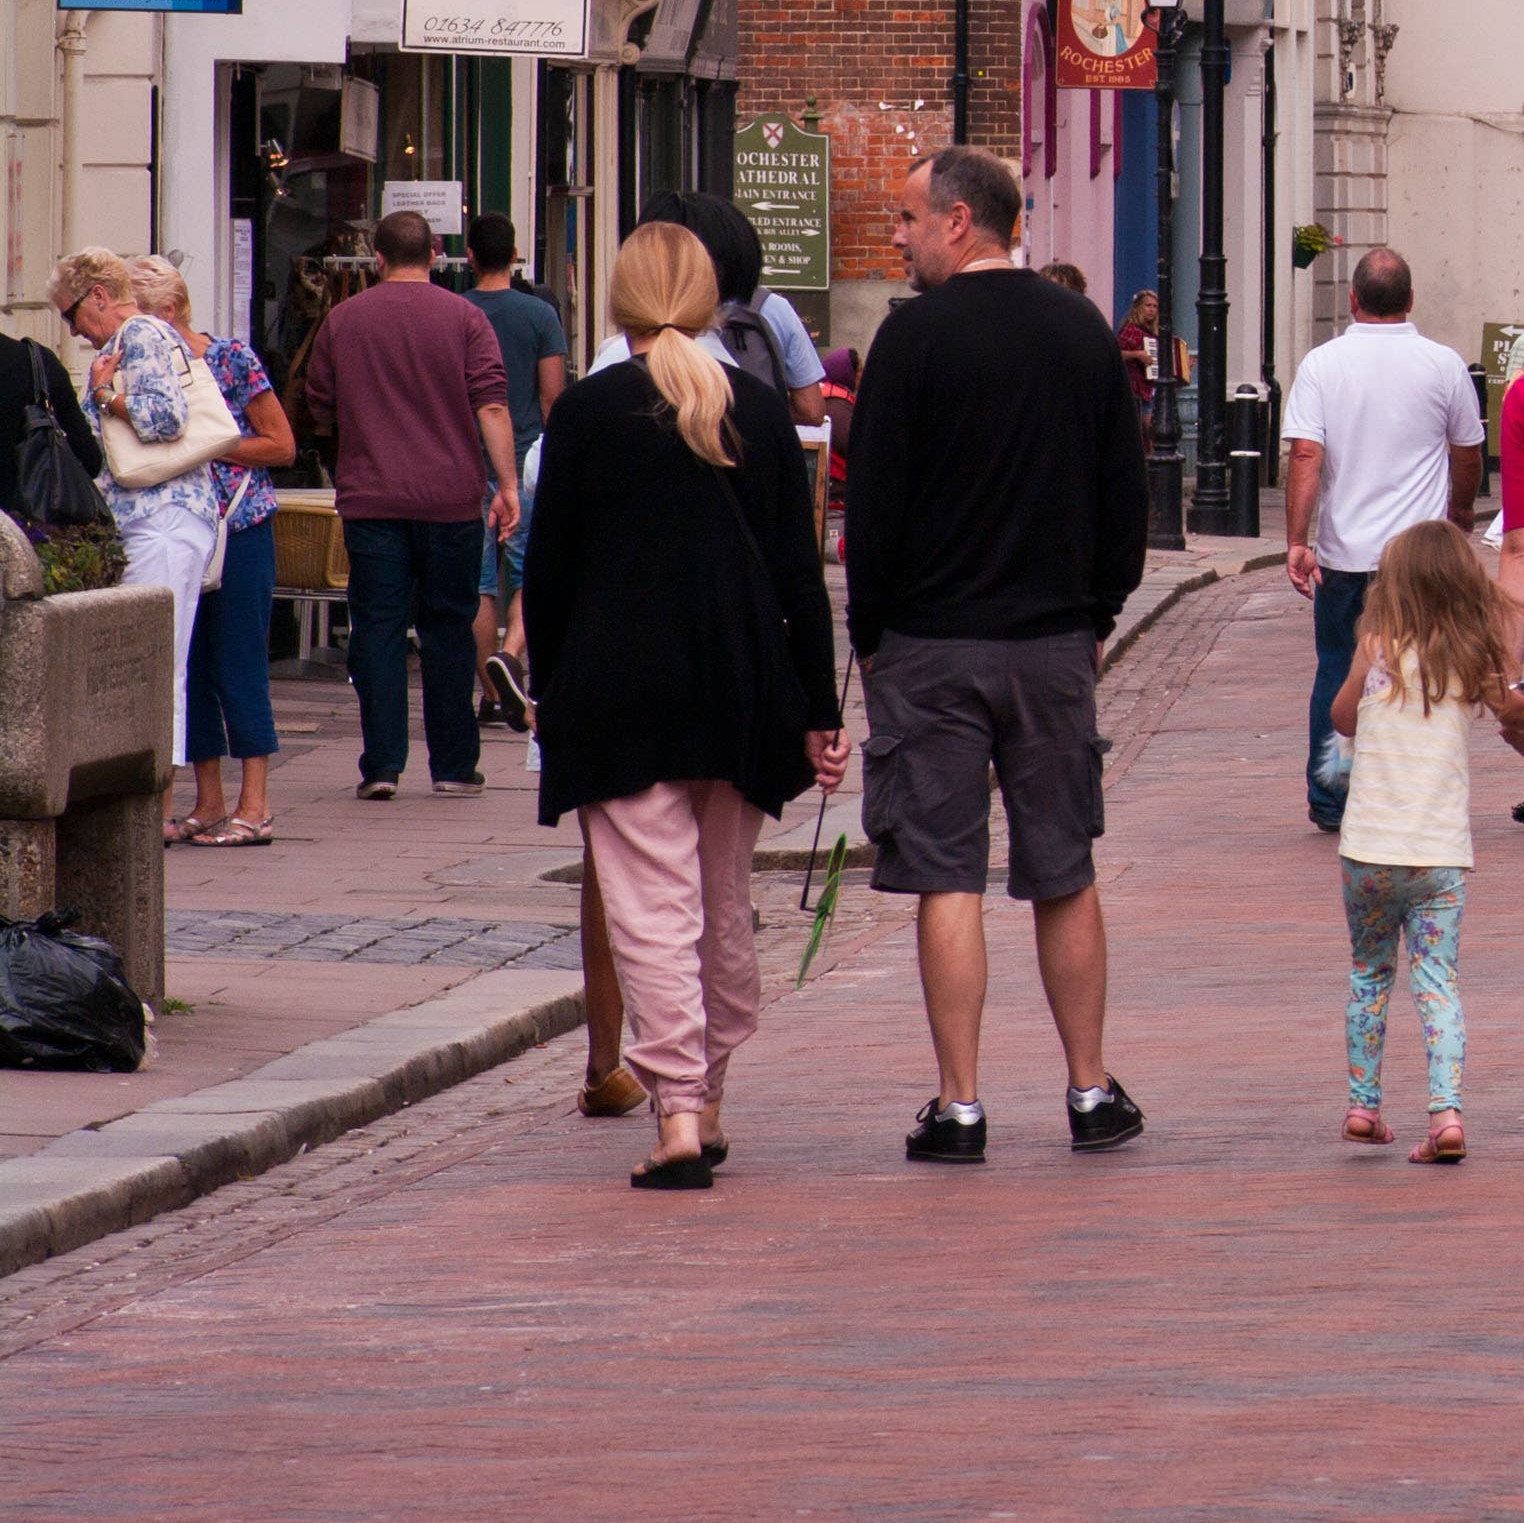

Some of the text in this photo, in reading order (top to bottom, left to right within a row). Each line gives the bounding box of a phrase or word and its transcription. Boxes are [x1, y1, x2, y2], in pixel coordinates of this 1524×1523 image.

[424, 16, 564, 38] 01634 847776
[423, 34, 566, 49] www.atrium-restaurant.com
[1060, 45, 1154, 74] ROCHESTER
[762, 188, 817, 201] ENTRANCE
[772, 217, 822, 228] ENTRANCE
[788, 255, 811, 265] SHOP
